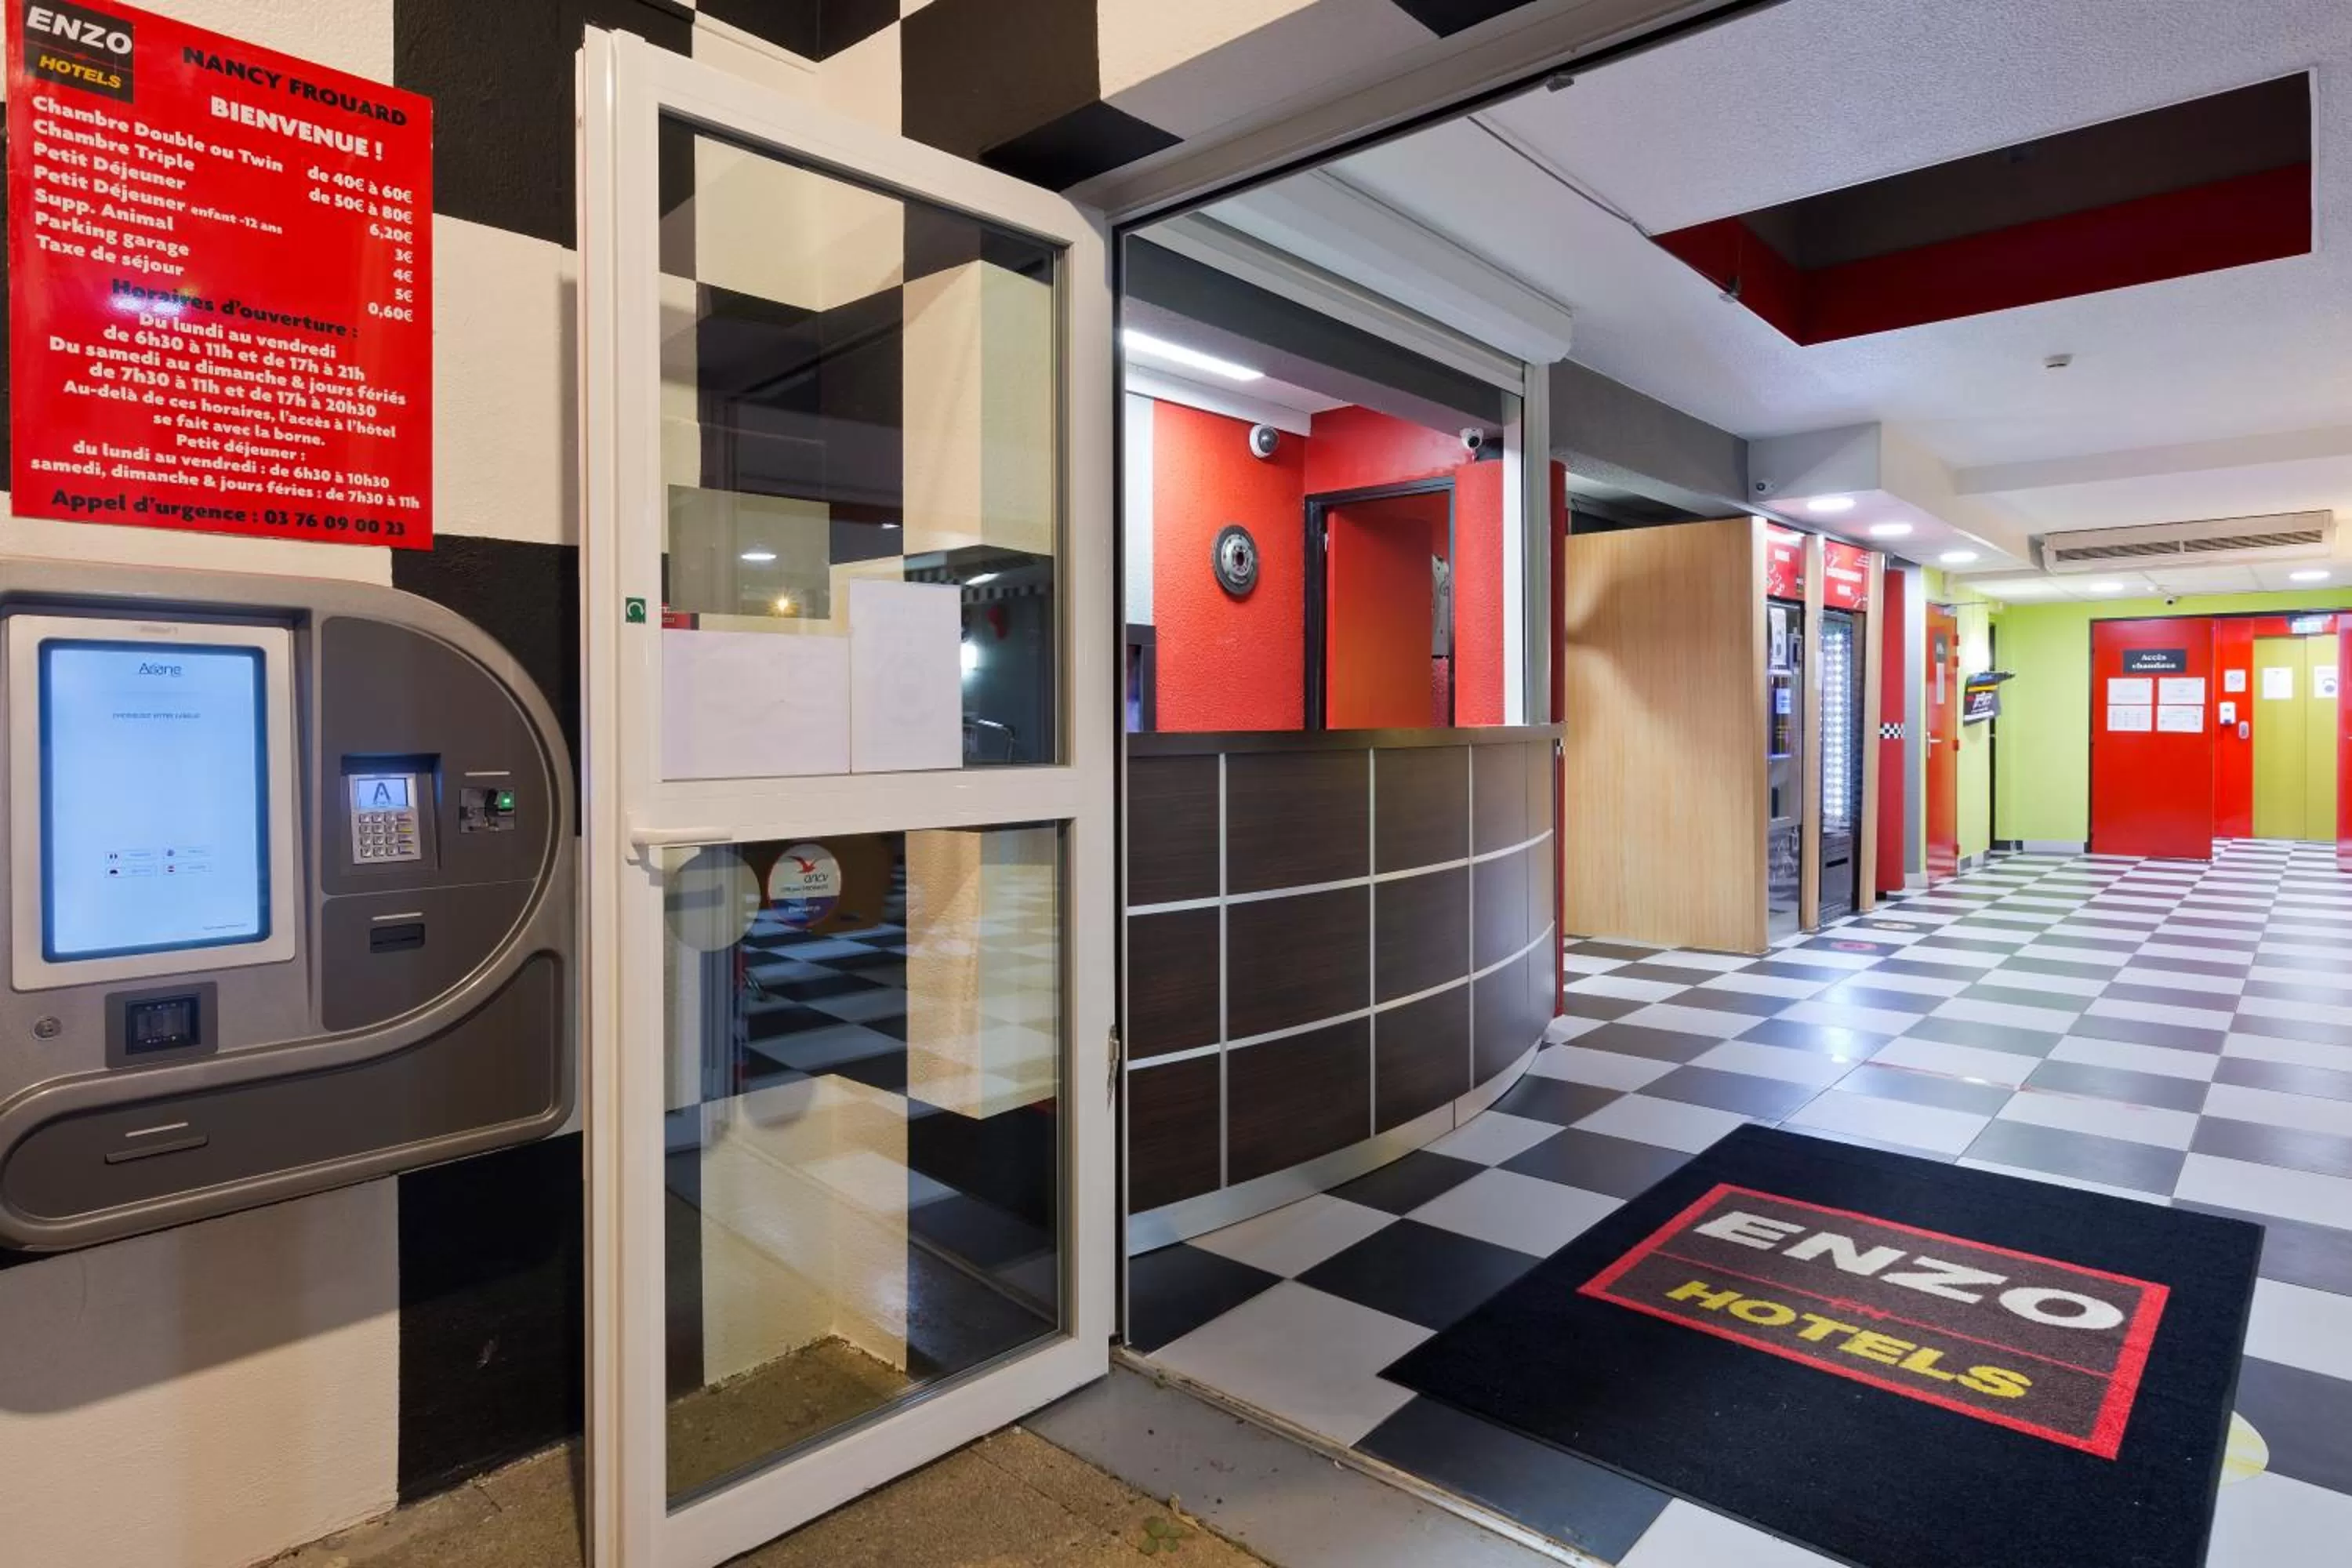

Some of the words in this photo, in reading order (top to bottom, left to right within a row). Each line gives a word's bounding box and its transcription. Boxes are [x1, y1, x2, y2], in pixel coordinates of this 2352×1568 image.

[26, 5, 132, 54] ENZO
[39, 55, 122, 89] HOTELS
[182, 46, 282, 89] NANCY
[289, 78, 408, 126] FROUARD
[32, 95, 129, 133] Chambre
[134, 121, 205, 153] Double
[210, 144, 234, 159] ou
[238, 148, 283, 172] Twin
[33, 119, 129, 155] Chambre
[135, 143, 195, 172] Triple
[211, 95, 369, 158] BIENVENUE
[375, 141, 384, 161] !
[34, 140, 88, 167] Petit
[93, 156, 187, 190] Déjeuner
[307, 165, 328, 183] de
[332, 175, 365, 192] 40€
[368, 180, 378, 195] à
[382, 185, 413, 204] 60€
[34, 164, 88, 190] Petit
[93, 179, 186, 212] Déjeuner
[191, 206, 236, 224] enfant
[239, 216, 258, 229] -12
[260, 222, 282, 235] ans
[34, 187, 96, 216] Supp.
[100, 203, 173, 230] Animal
[308, 187, 330, 205] de
[334, 194, 364, 212] 50€
[368, 201, 378, 216] à
[382, 205, 413, 225] 80€
[34, 211, 117, 245] Parking
[122, 233, 189, 257] garage
[35, 234, 85, 257] Taxe
[90, 245, 116, 263] de
[122, 254, 184, 276] séjour
[369, 223, 413, 244] 6,20€
[394, 249, 413, 263] 3€
[393, 268, 413, 283] 4€
[394, 288, 413, 303] 5€
[112, 278, 215, 312] Horaires
[221, 299, 347, 336] d'ouverture
[368, 302, 413, 322] 0,60€
[103, 324, 129, 342] de
[135, 330, 184, 350] 6h30
[189, 339, 201, 354] à
[205, 343, 234, 359] 11h
[238, 351, 258, 363] et
[263, 353, 285, 368] de
[289, 357, 318, 374] 17h
[323, 362, 332, 376] à
[338, 365, 365, 381] 21h
[140, 314, 168, 329] Du
[173, 317, 223, 339] lundi
[228, 330, 251, 343] au
[256, 336, 336, 358] vendredi
[49, 336, 80, 354] Du
[85, 344, 161, 367] samedi
[165, 358, 190, 372] au
[195, 359, 287, 387] dimanche
[292, 376, 305, 389] &
[309, 378, 354, 397] jours
[358, 386, 406, 405] fériés
[89, 362, 115, 379] de
[121, 367, 169, 387] 7h30
[175, 376, 186, 390] à
[191, 378, 220, 394] 11h
[225, 385, 245, 398] et
[249, 387, 271, 402] de
[277, 391, 307, 408] 17h
[311, 397, 321, 410] à
[325, 398, 376, 418] 20h30
[64, 380, 138, 402] Au-delà
[142, 391, 165, 406] de
[169, 397, 196, 410] ces
[201, 398, 275, 423] horaires,
[334, 418, 343, 431] à
[153, 415, 172, 426] se
[176, 414, 209, 430] fait
[213, 423, 250, 437] avec
[254, 424, 270, 438] la
[274, 426, 325, 446] borne.
[176, 434, 220, 451] Petit
[224, 439, 296, 460] déjeuner
[31, 459, 106, 479] samedi,
[111, 464, 199, 487] dimanche
[203, 474, 216, 488] &
[220, 477, 263, 492] jours
[325, 488, 344, 501] de
[348, 491, 383, 505] 7h30
[387, 495, 395, 507] à
[399, 496, 420, 510] 11h
[73, 440, 98, 456] du
[102, 442, 151, 462] lundi
[155, 452, 176, 465] au
[181, 456, 257, 474] vendredi
[270, 463, 289, 477] de
[293, 466, 331, 482] 6h30
[335, 470, 343, 484] à
[347, 473, 390, 488] 10h30
[52, 489, 126, 514] Appel
[133, 495, 245, 521] d'urgence
[263, 510, 289, 525] 03
[296, 513, 318, 528] 76
[324, 515, 348, 530] 09
[355, 519, 379, 533] 00
[385, 521, 405, 536] 23
[1693, 1210, 2125, 1330] ENZO
[1663, 1279, 2032, 1399] HOTELS
